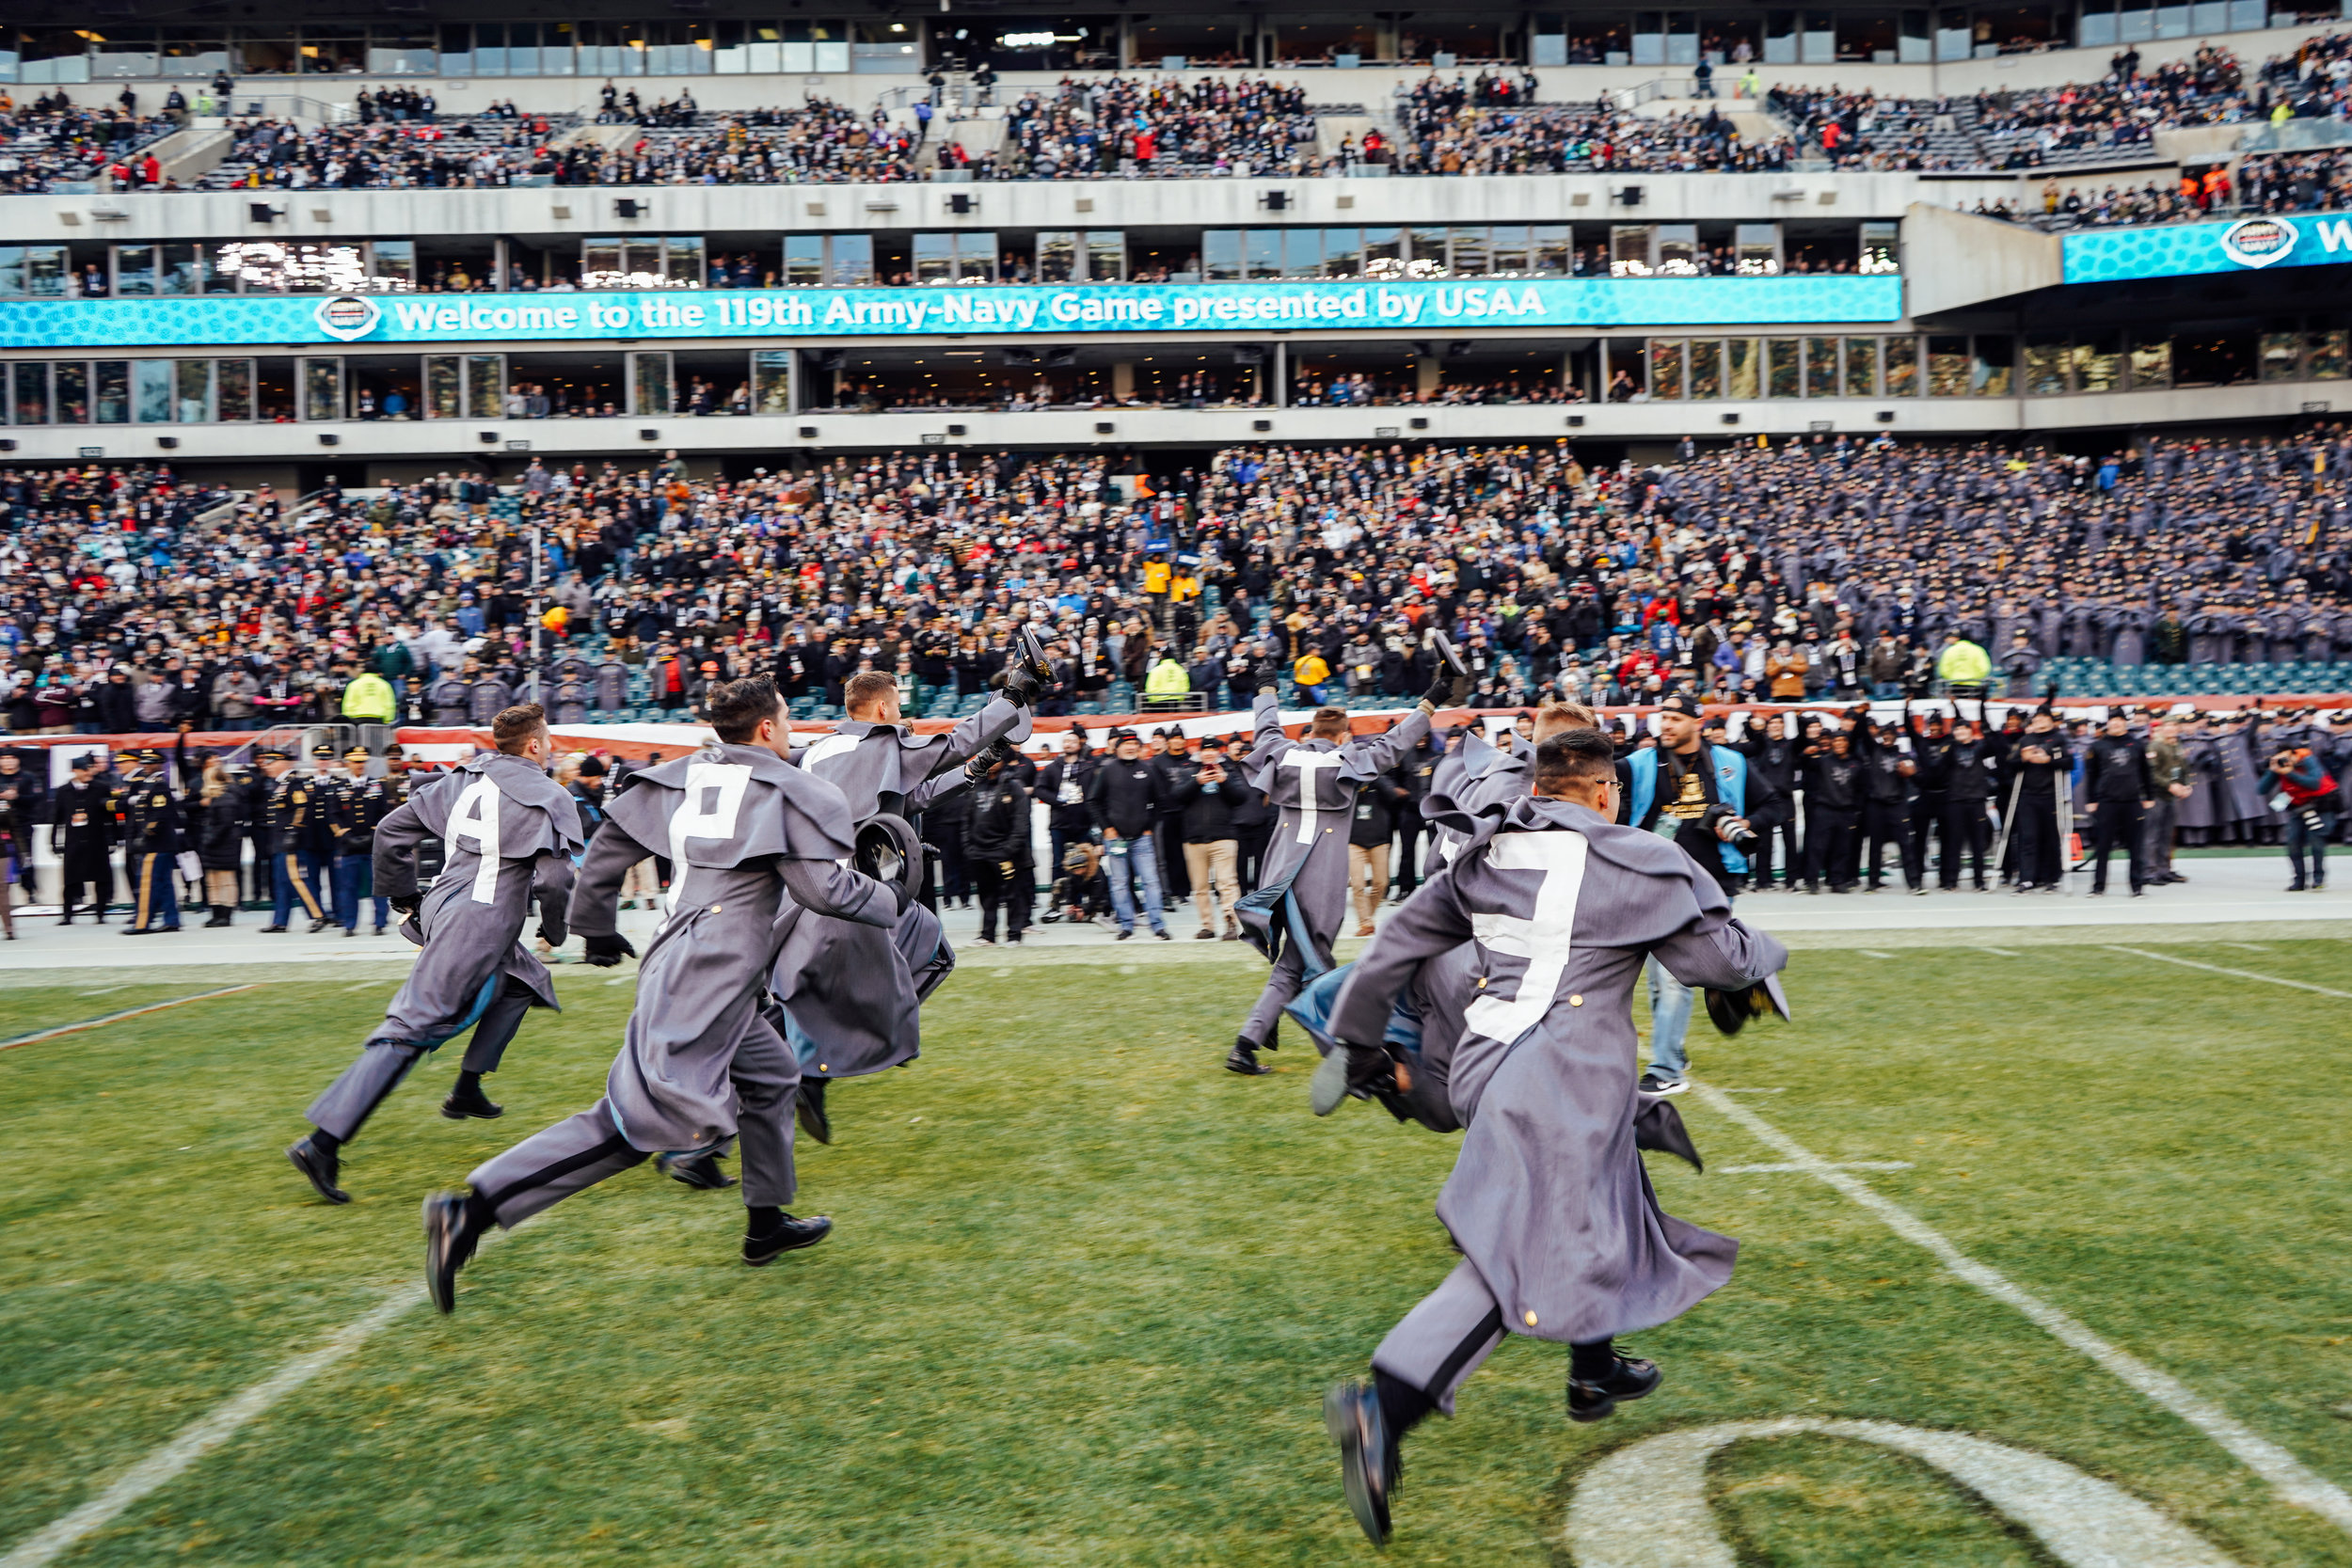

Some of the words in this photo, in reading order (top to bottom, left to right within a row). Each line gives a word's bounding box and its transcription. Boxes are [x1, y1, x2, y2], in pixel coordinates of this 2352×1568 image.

[395, 300, 579, 331] Welcome
[589, 300, 629, 329] to
[641, 297, 705, 328] the
[715, 295, 813, 327] 119th
[825, 293, 1040, 330] Army-Navy
[1051, 292, 1164, 323] Game
[1176, 287, 1367, 326] presented
[1378, 287, 1425, 323] by
[1436, 287, 1548, 318] USAA
[431, 773, 500, 904] A
[657, 763, 753, 934] P
[1277, 749, 1344, 845] T
